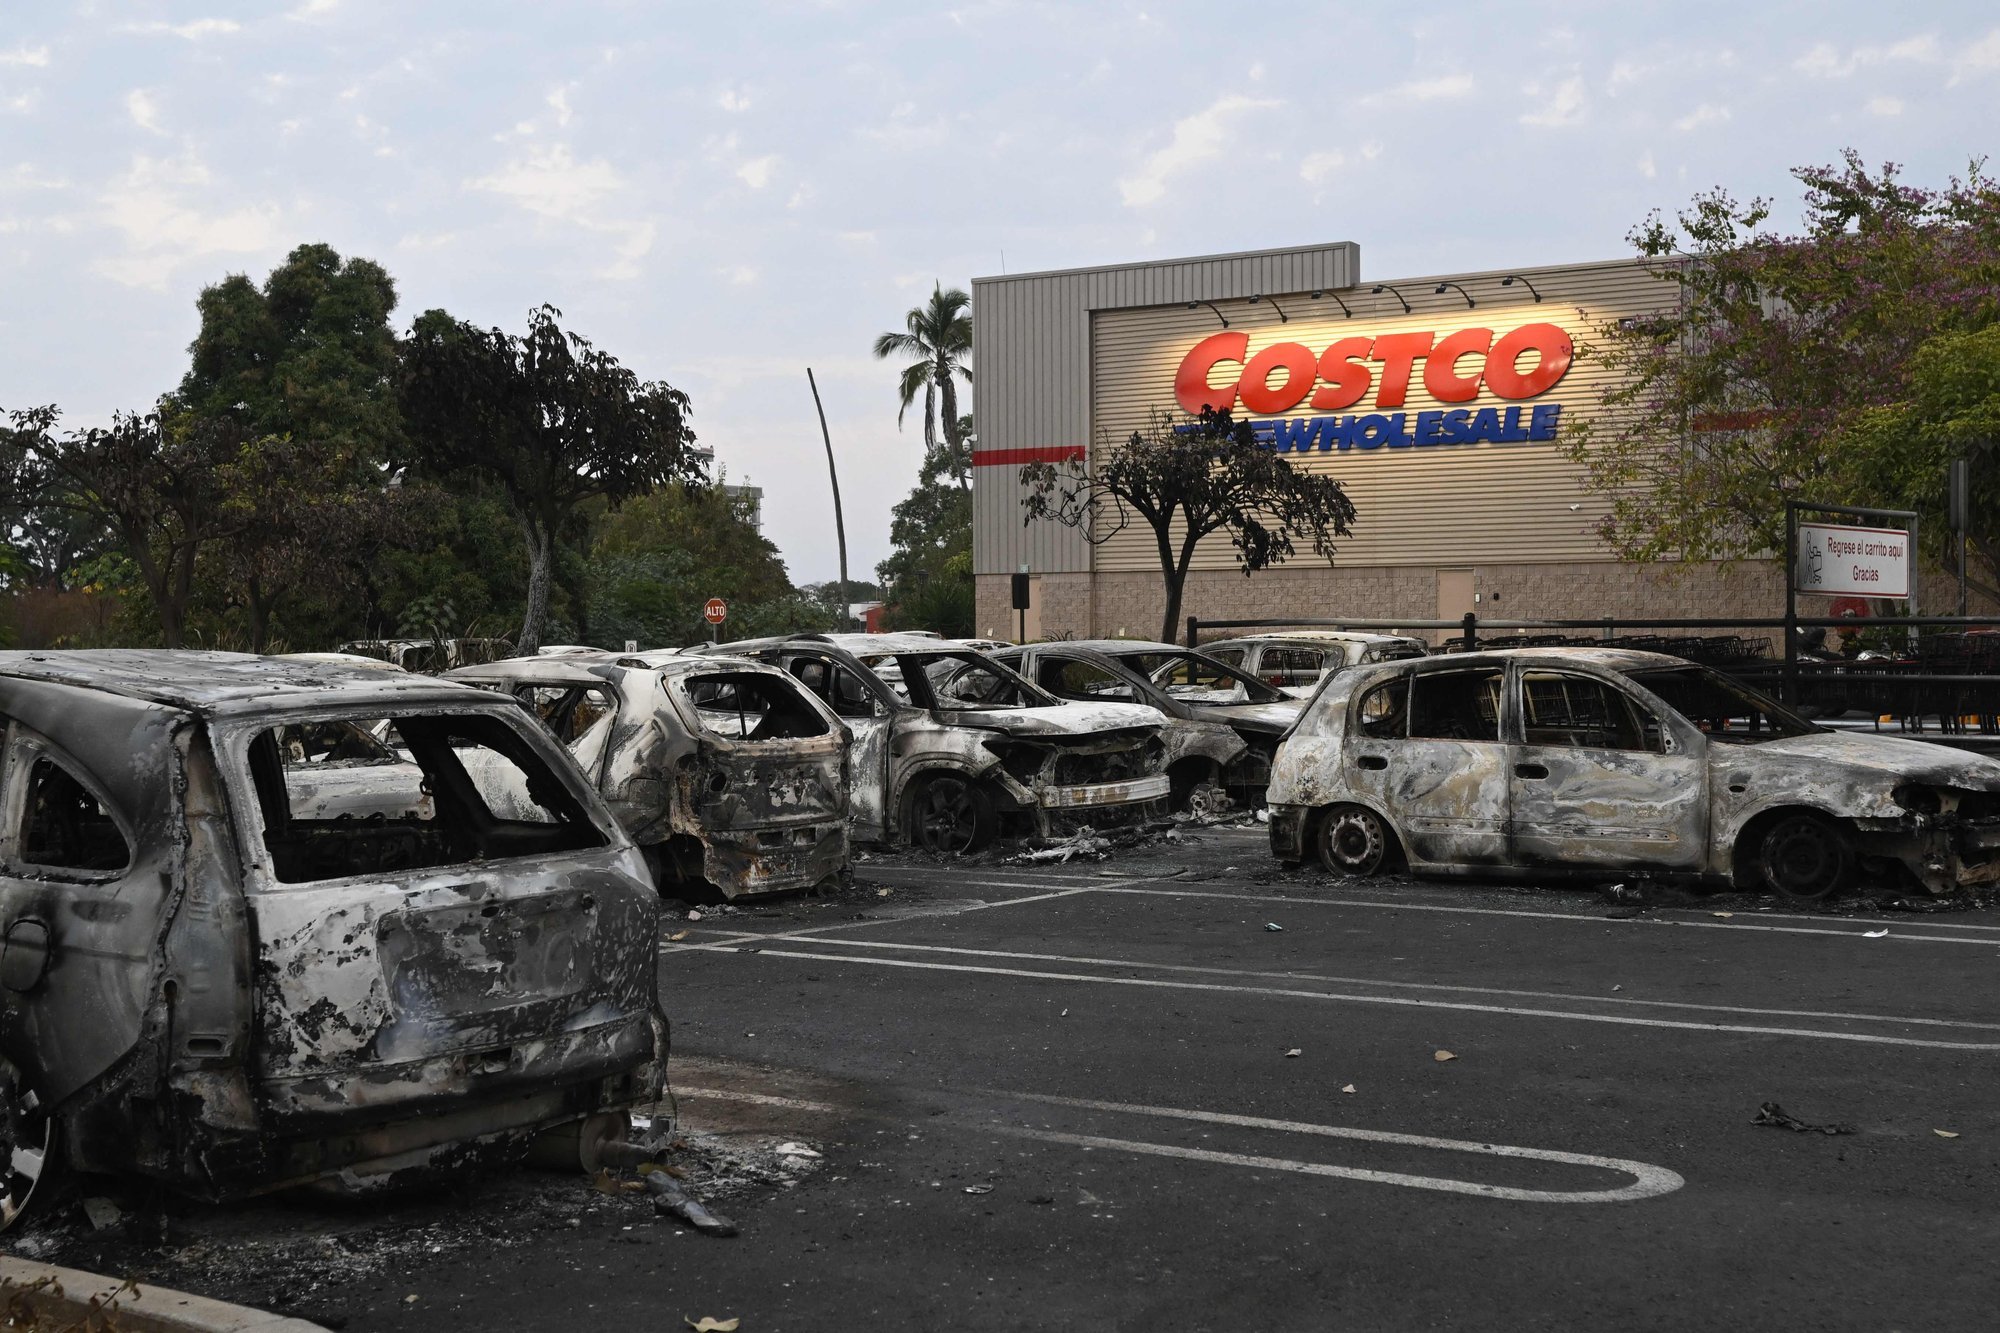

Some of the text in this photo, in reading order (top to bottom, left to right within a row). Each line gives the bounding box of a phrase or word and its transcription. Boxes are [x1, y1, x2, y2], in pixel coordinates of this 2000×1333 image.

[1174, 323, 1573, 416] COSTCO
[1272, 404, 1560, 453] WHOLESALE
[1828, 537, 1903, 561] Regrese el carrito aquí
[1853, 565, 1879, 581] Gracias
[706, 606, 725, 616] ALTO
